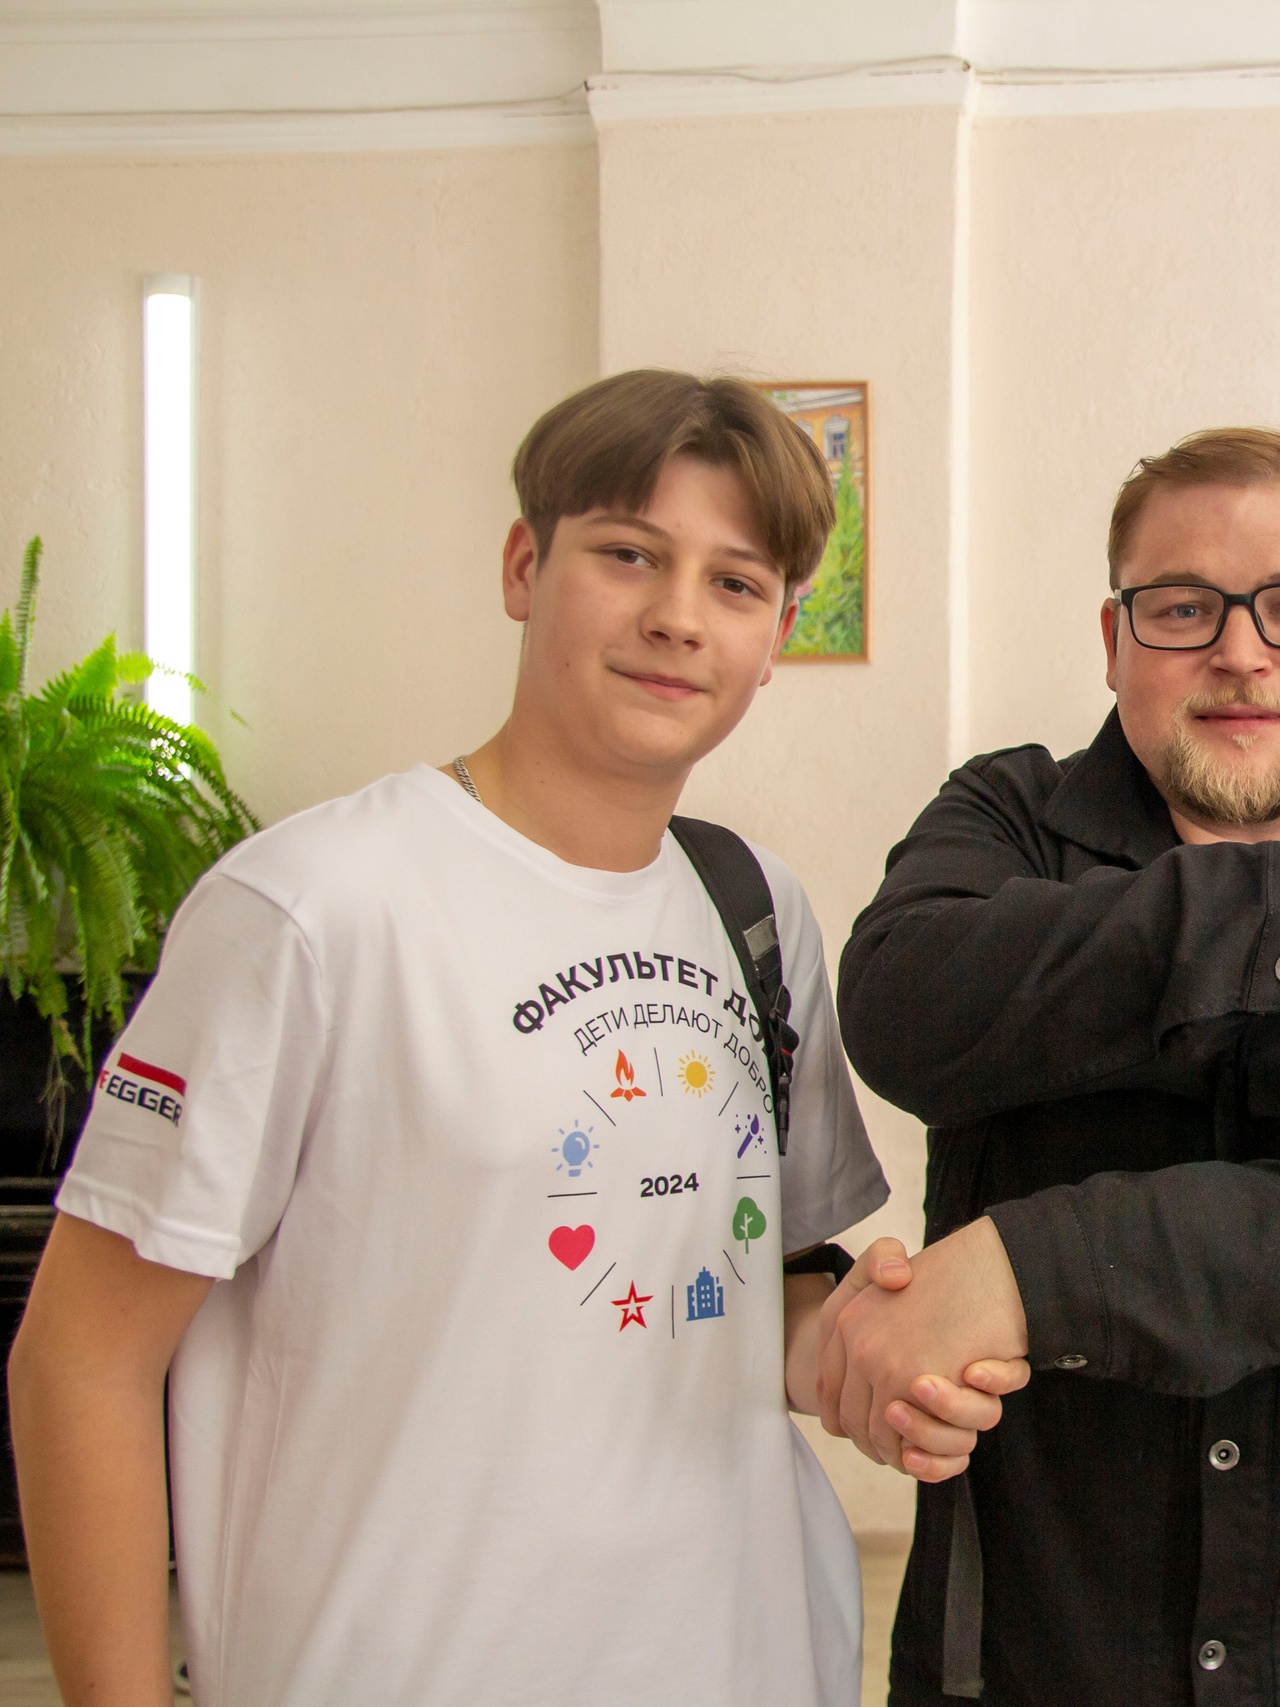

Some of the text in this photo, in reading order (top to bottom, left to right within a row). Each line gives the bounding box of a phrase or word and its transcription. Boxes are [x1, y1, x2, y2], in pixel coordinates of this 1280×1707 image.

[512, 951, 719, 1035] ФАКУЛЬТЕТ
[573, 1007, 629, 1057] ДЕТИ
[633, 1003, 723, 1039] ДЕЛАЮТ
[723, 1033, 774, 1114] ДОБРО
[105, 1074, 183, 1128] EGGER
[640, 1172, 700, 1198] 2024
